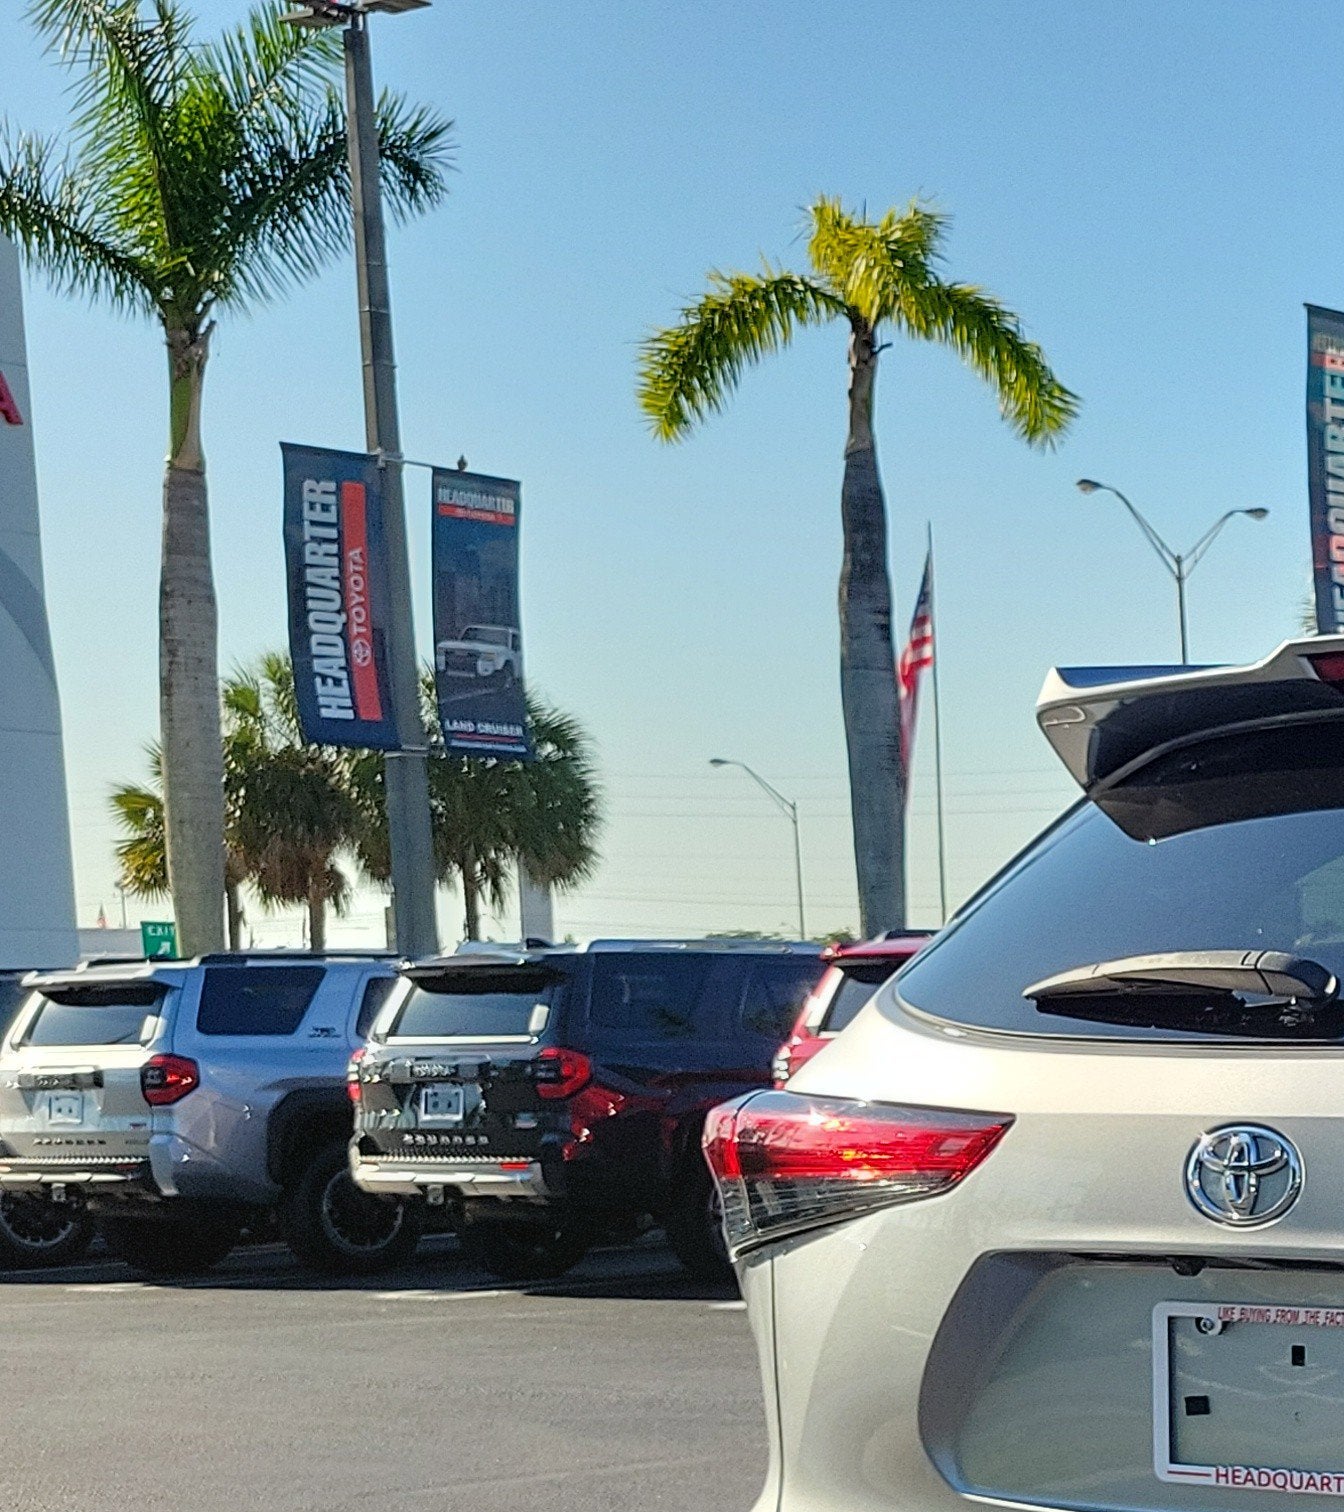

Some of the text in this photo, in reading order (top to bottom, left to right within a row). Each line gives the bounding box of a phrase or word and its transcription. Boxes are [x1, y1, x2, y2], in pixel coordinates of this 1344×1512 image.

[303, 479, 355, 721] HEADQUARTER
[349, 547, 368, 635] TOYOTA
[1218, 1306, 1236, 1321] LIKE
[1240, 1307, 1271, 1323] BUYING
[1275, 1308, 1300, 1324] FROM
[1304, 1310, 1321, 1325] THE
